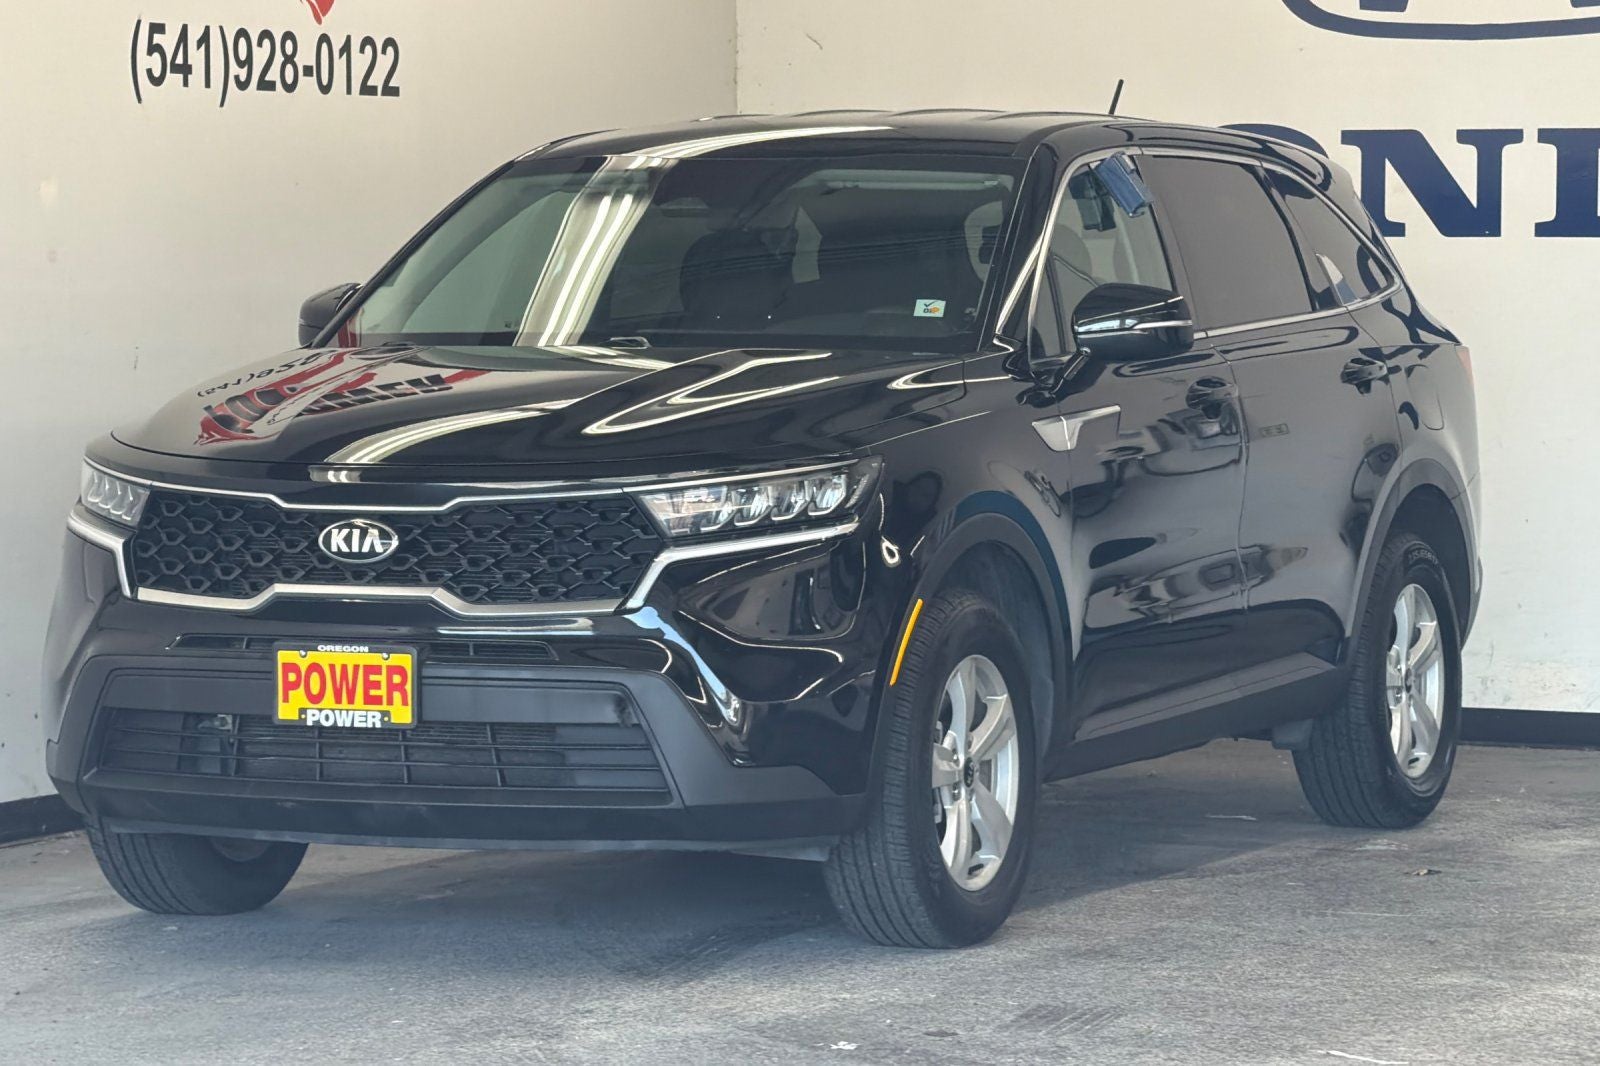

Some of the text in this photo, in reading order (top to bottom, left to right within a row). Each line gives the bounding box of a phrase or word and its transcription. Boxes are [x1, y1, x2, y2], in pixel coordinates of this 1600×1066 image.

[131, 19, 401, 108] (541)928-0122
[330, 528, 384, 553] KIA
[317, 644, 369, 653] OREGON
[281, 662, 409, 706] POWER
[306, 708, 382, 728] POWER
